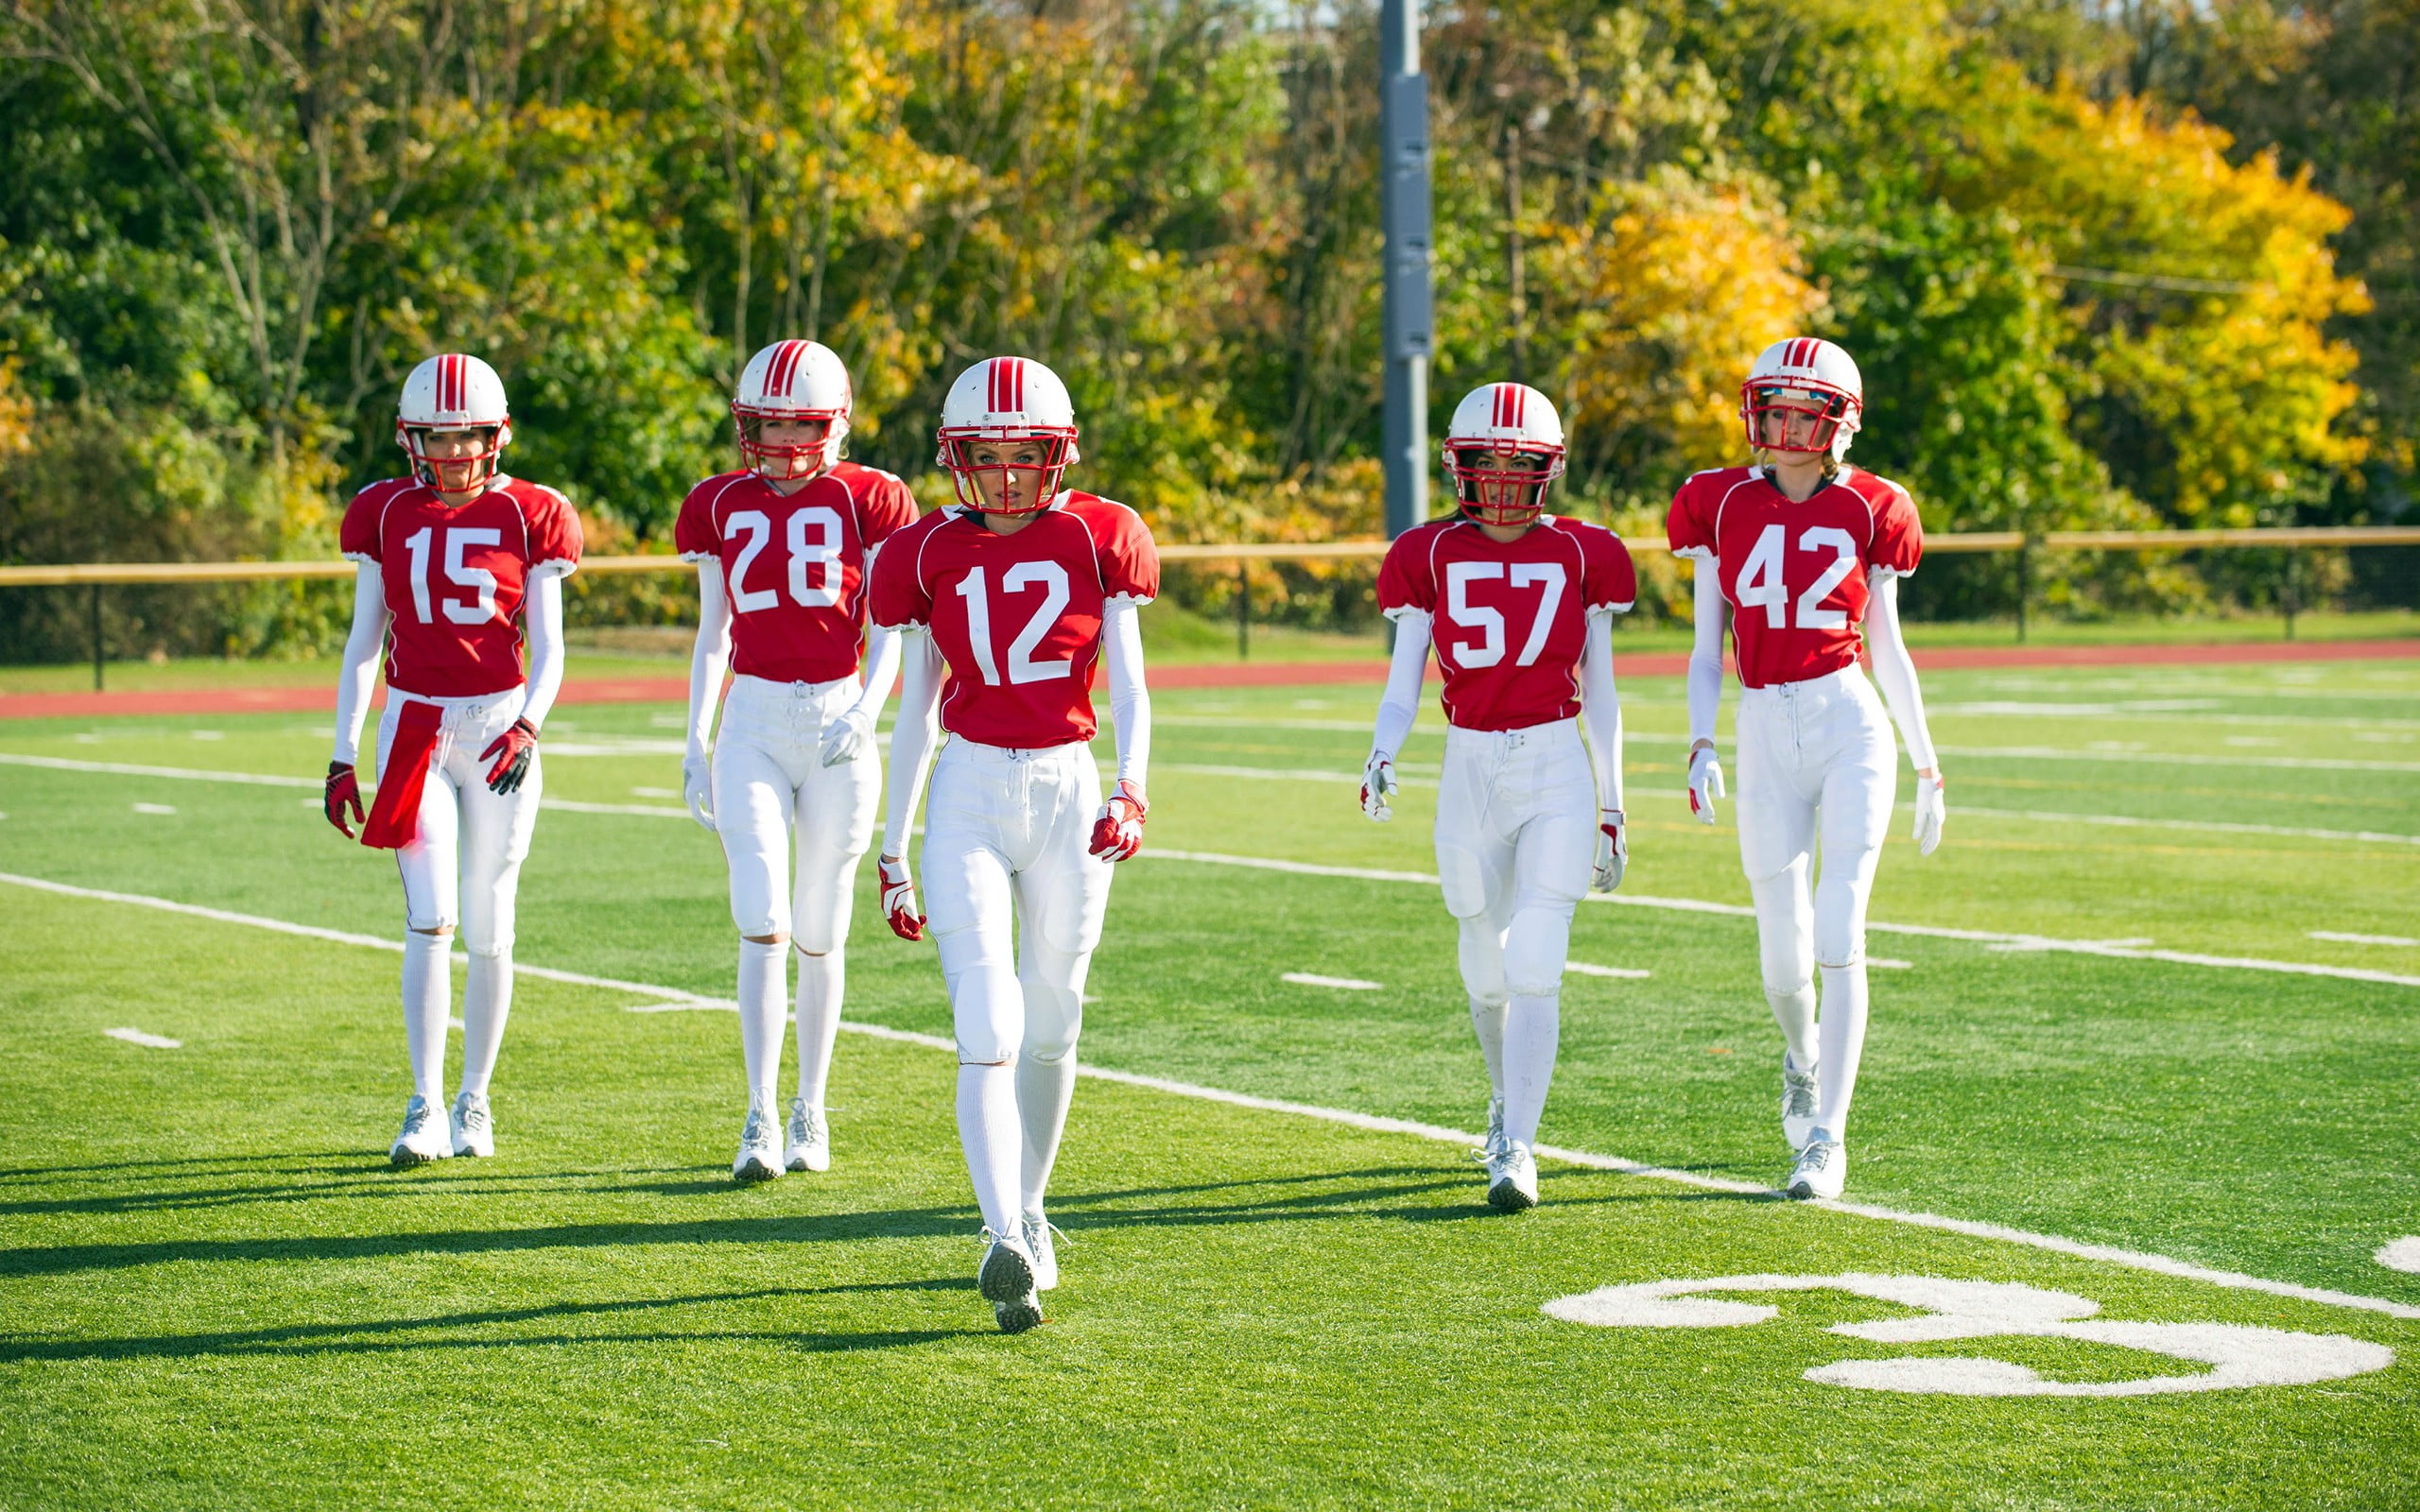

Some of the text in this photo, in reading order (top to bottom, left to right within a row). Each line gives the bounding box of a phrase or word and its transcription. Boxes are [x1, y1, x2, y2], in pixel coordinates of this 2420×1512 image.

[405, 526, 501, 625] 15
[724, 506, 844, 614] 28
[1736, 524, 1858, 630] 42
[956, 559, 1071, 686] 12
[1446, 561, 1567, 669] 57
